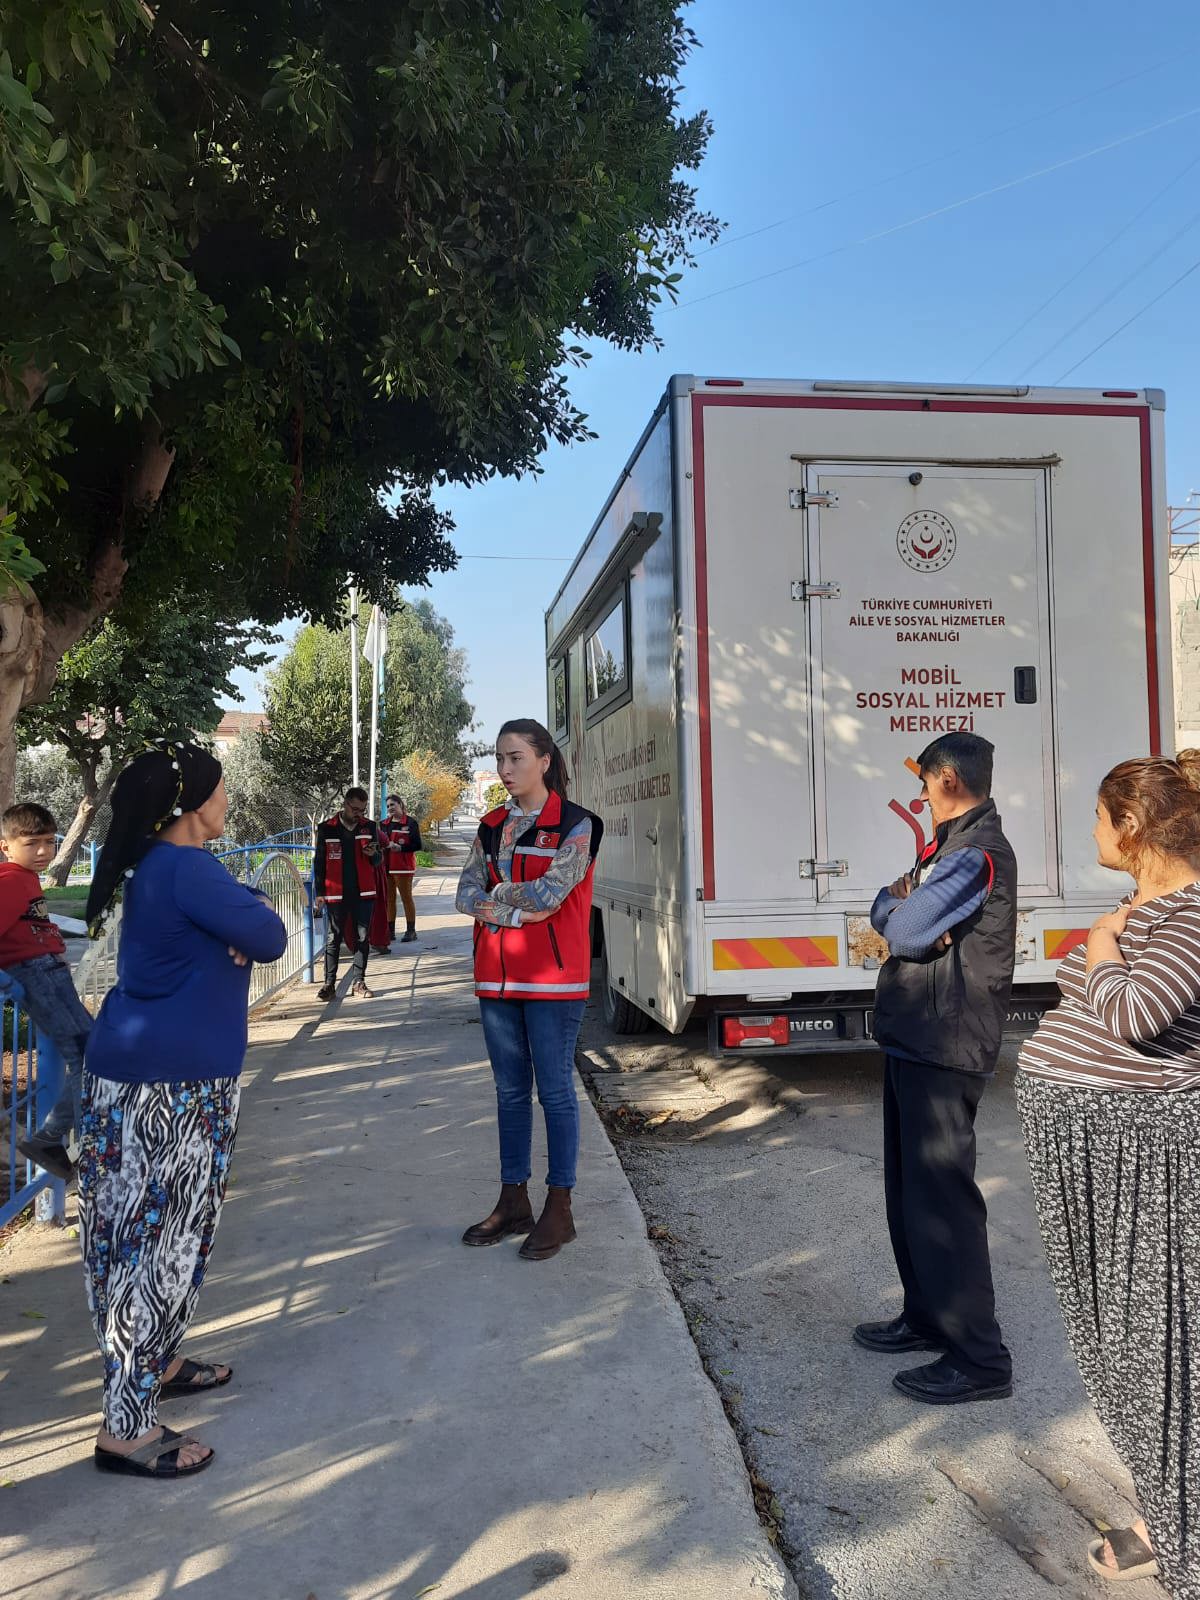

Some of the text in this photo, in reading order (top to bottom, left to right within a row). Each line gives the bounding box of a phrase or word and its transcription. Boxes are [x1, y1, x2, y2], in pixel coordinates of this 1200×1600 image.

[861, 598, 992, 610] TÜRKİYE CUMHURİYETİ
[849, 614, 1005, 626] AİLE VE SOSYAL HİZMETLER
[896, 630, 960, 642] BAKANLIĞI
[901, 664, 961, 685] MOBİL
[856, 688, 1006, 708] SOSYAL HİZMET
[890, 712, 974, 732] MERKEZİ
[790, 1020, 834, 1031] IVECO
